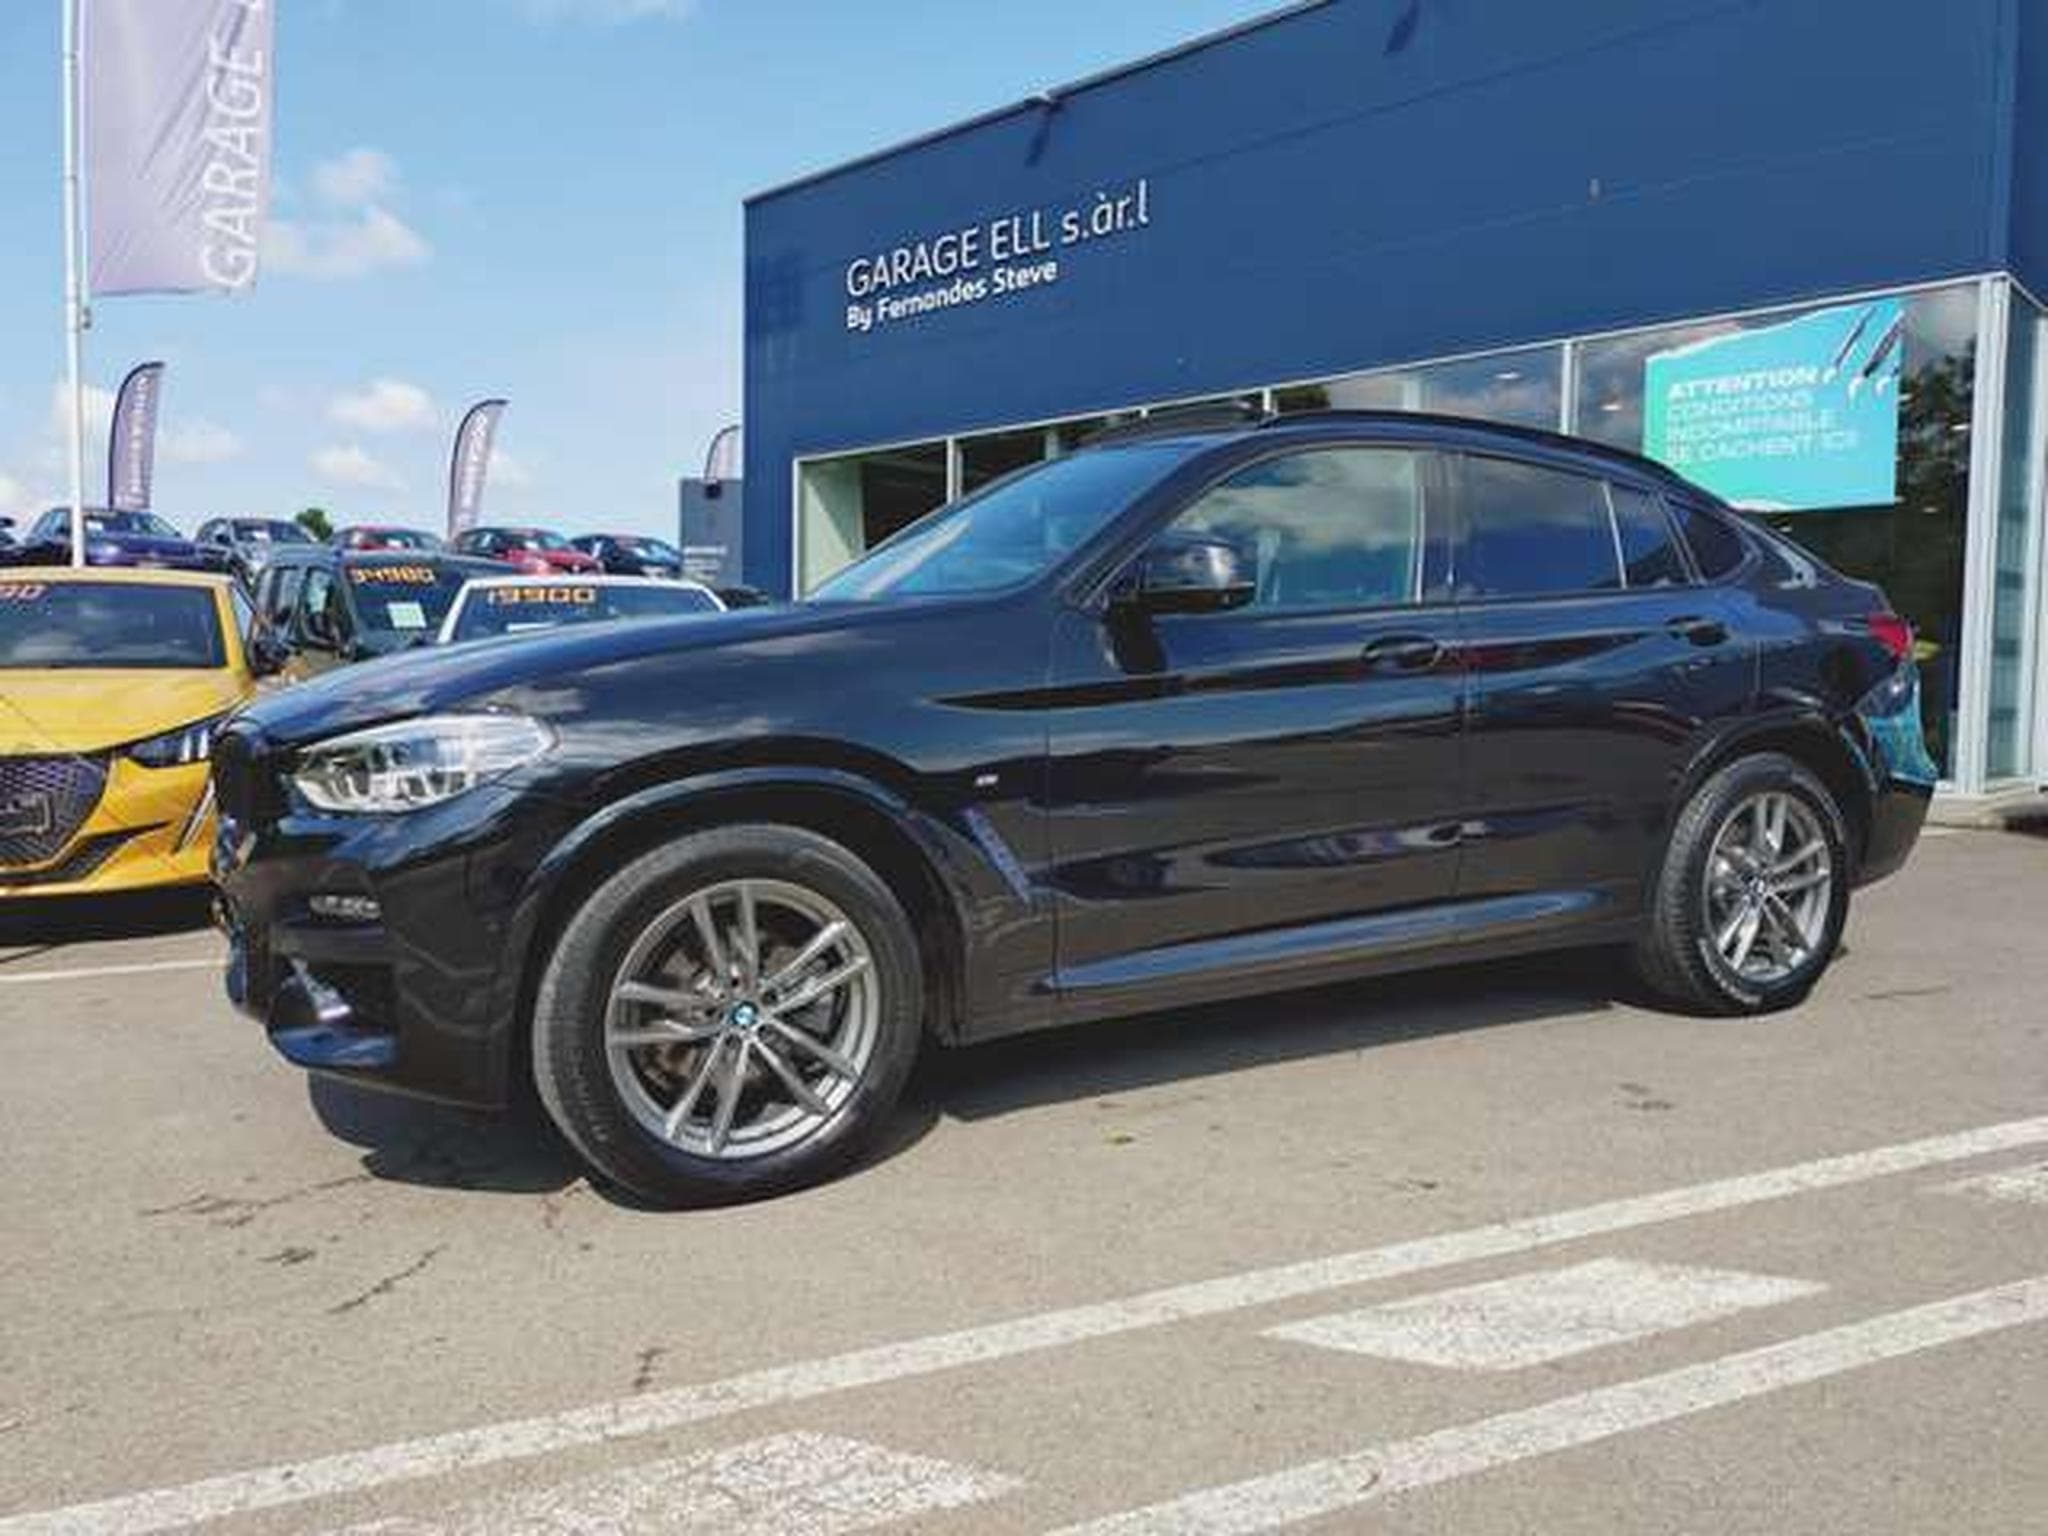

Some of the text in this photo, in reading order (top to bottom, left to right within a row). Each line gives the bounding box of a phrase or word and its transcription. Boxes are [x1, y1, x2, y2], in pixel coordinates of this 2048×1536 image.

[202, 36, 262, 287] GARAGE
[847, 226, 980, 297] GARAGE
[990, 210, 1051, 260] ELL
[847, 261, 1058, 332] By Fernandes Steve
[1667, 366, 1819, 399] ATTENTION
